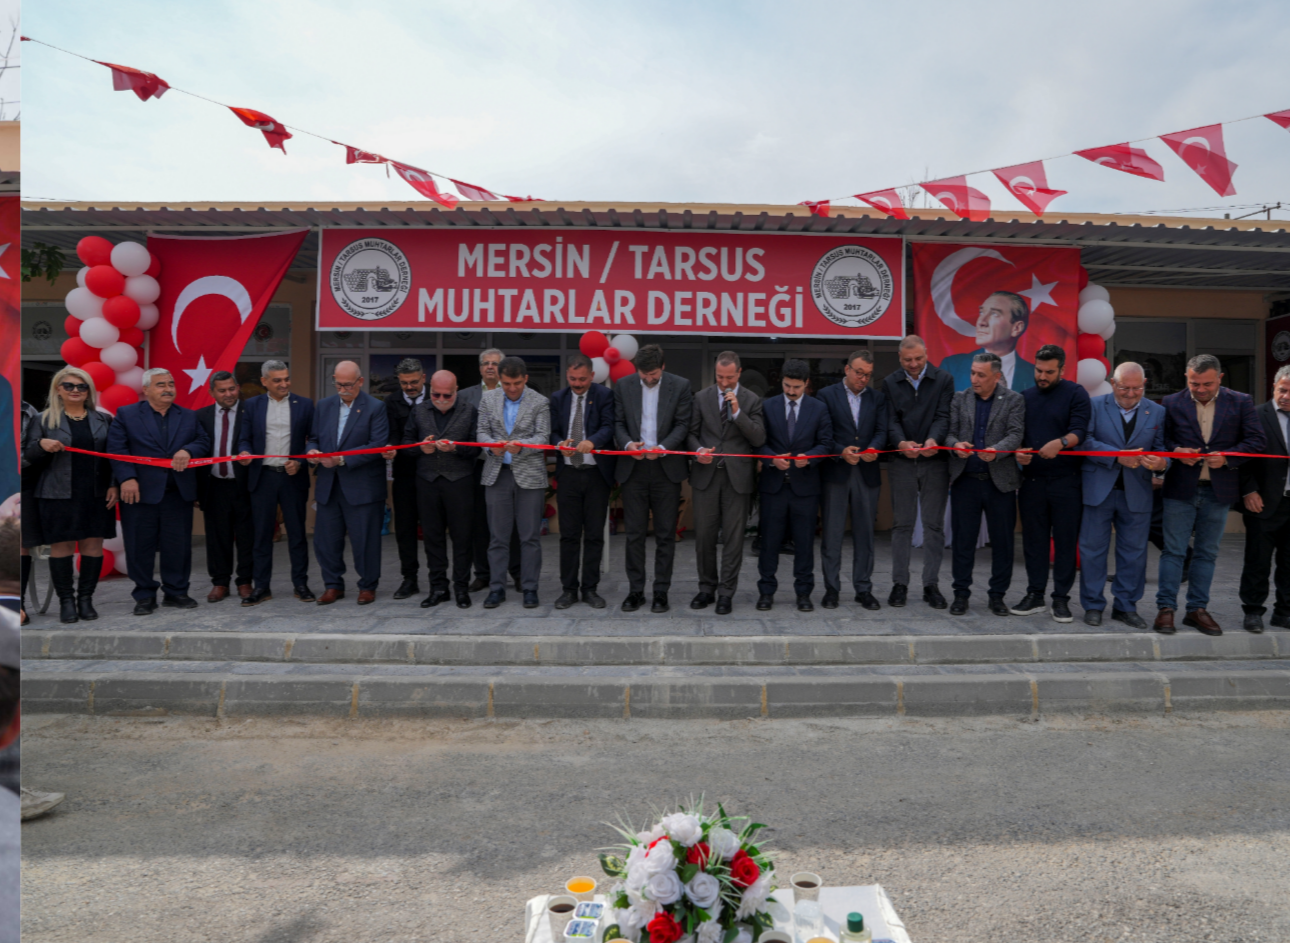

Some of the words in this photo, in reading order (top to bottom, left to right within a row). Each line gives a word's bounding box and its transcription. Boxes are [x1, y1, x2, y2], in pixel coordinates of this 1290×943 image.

[457, 236, 590, 279] MERSİN
[599, 240, 620, 284] /
[628, 244, 765, 282] TARSUS
[417, 287, 636, 325] MUHTARLAR
[654, 285, 804, 329] DERNEĞİ
